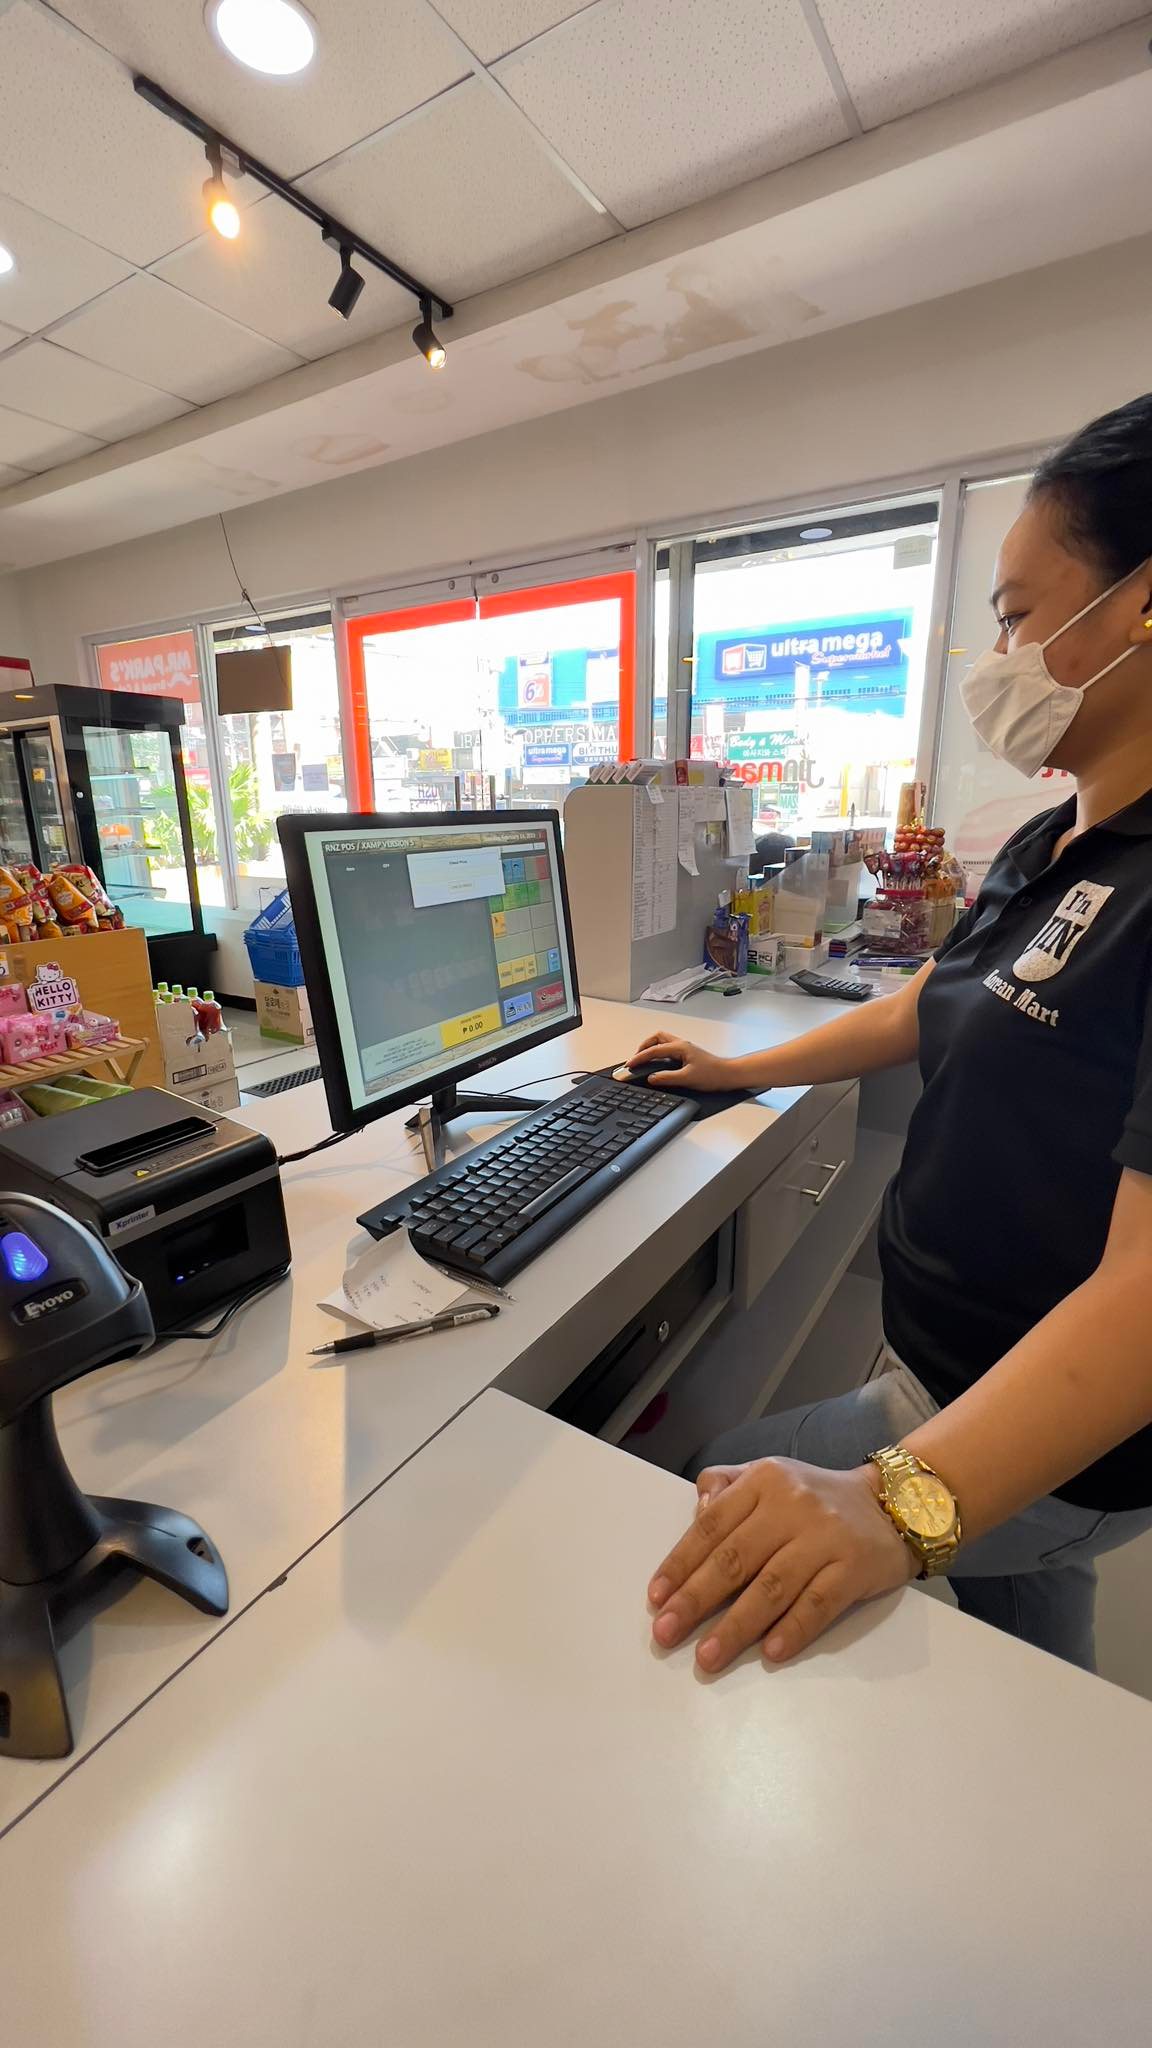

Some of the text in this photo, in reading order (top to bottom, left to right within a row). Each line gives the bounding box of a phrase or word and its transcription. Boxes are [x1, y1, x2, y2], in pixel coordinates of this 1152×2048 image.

[771, 631, 883, 657] ultra mega
[505, 726, 587, 744] SOPPERS
[341, 842, 356, 852] POS
[35, 981, 71, 997] HELLO
[37, 992, 72, 1008] KITTY
[1013, 988, 1060, 1027] Mart
[115, 1209, 150, 1230] Xprinter
